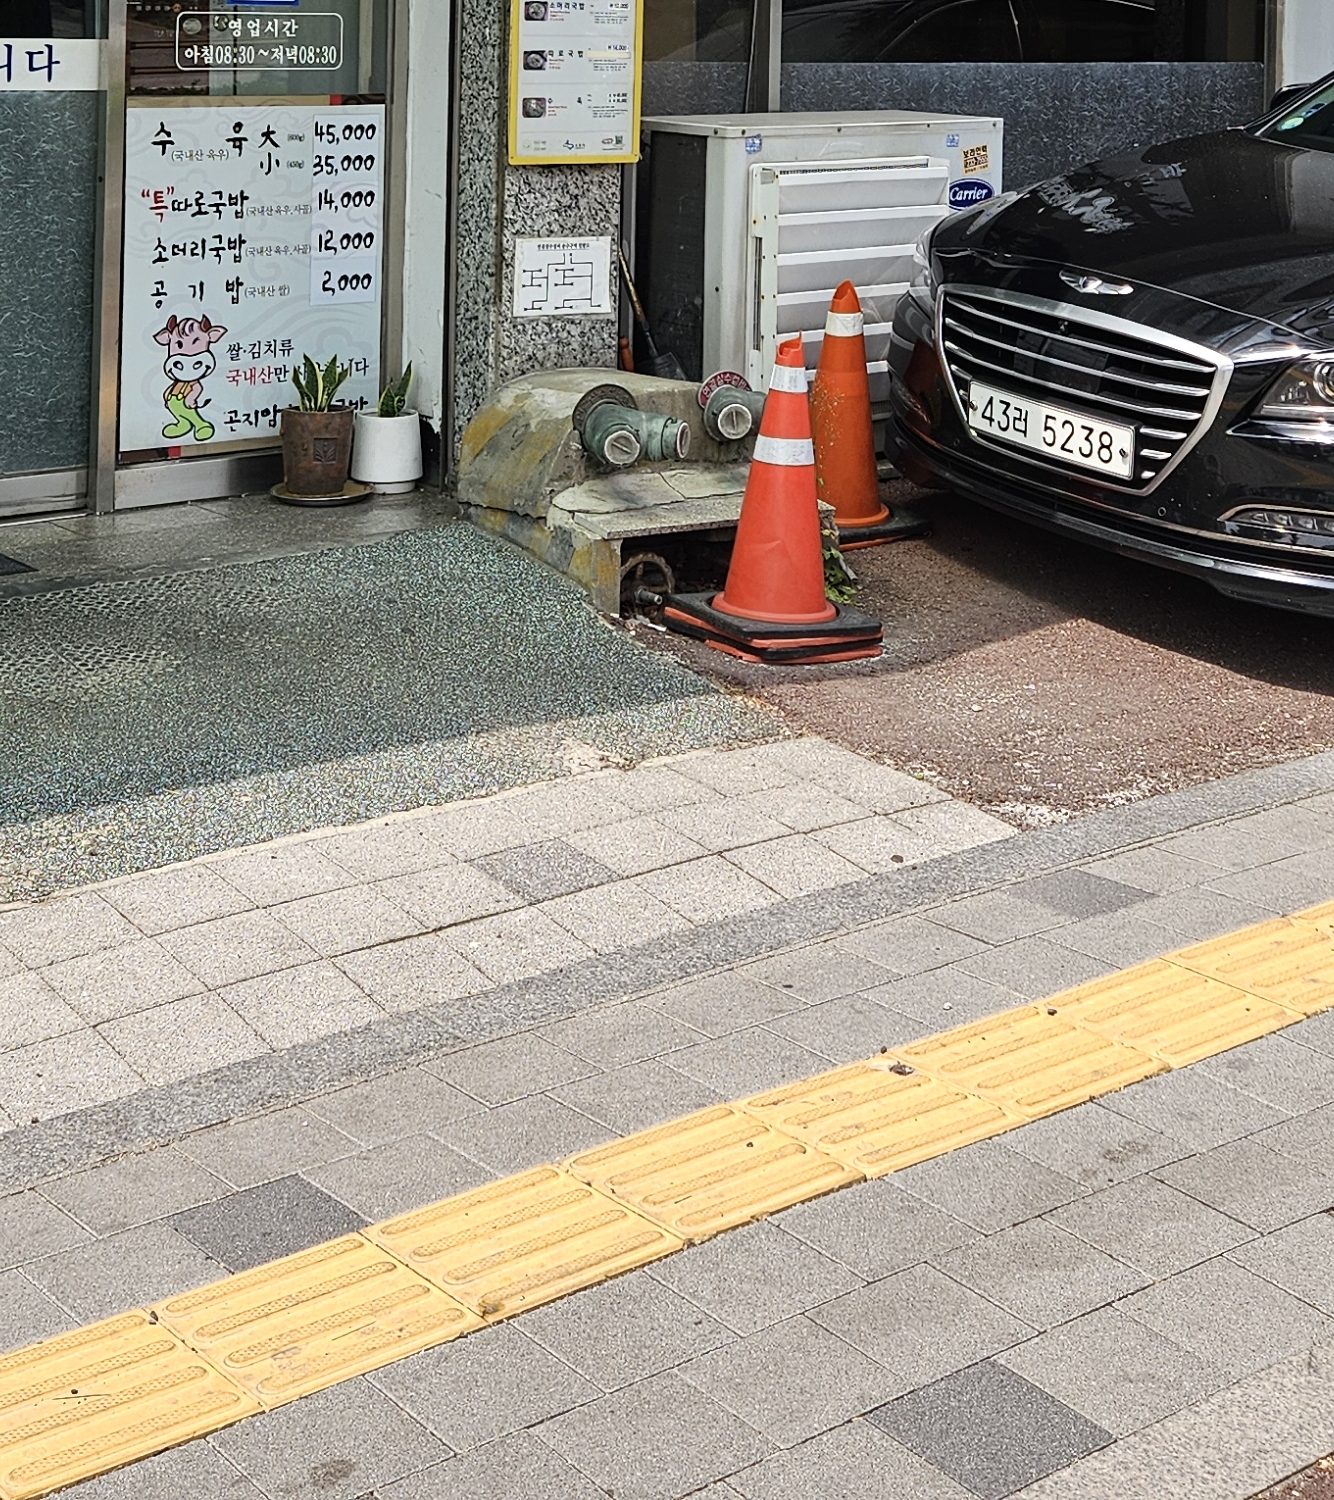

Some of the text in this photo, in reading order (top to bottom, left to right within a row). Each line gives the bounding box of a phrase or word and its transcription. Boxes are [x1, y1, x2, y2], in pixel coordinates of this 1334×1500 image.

[228, 19, 298, 37] 영업시간
[258, 124, 281, 149] 大
[314, 120, 377, 146] 45,000
[259, 152, 281, 177] 小
[313, 154, 376, 178] 35,000
[318, 189, 376, 214] 14,000
[949, 186, 988, 202] Carrier
[152, 233, 247, 265] 소머리국밥
[318, 230, 375, 255] 12,000
[321, 270, 373, 292] 2,000
[226, 364, 290, 387] 국내산만
[1042, 414, 1113, 464] 5238
